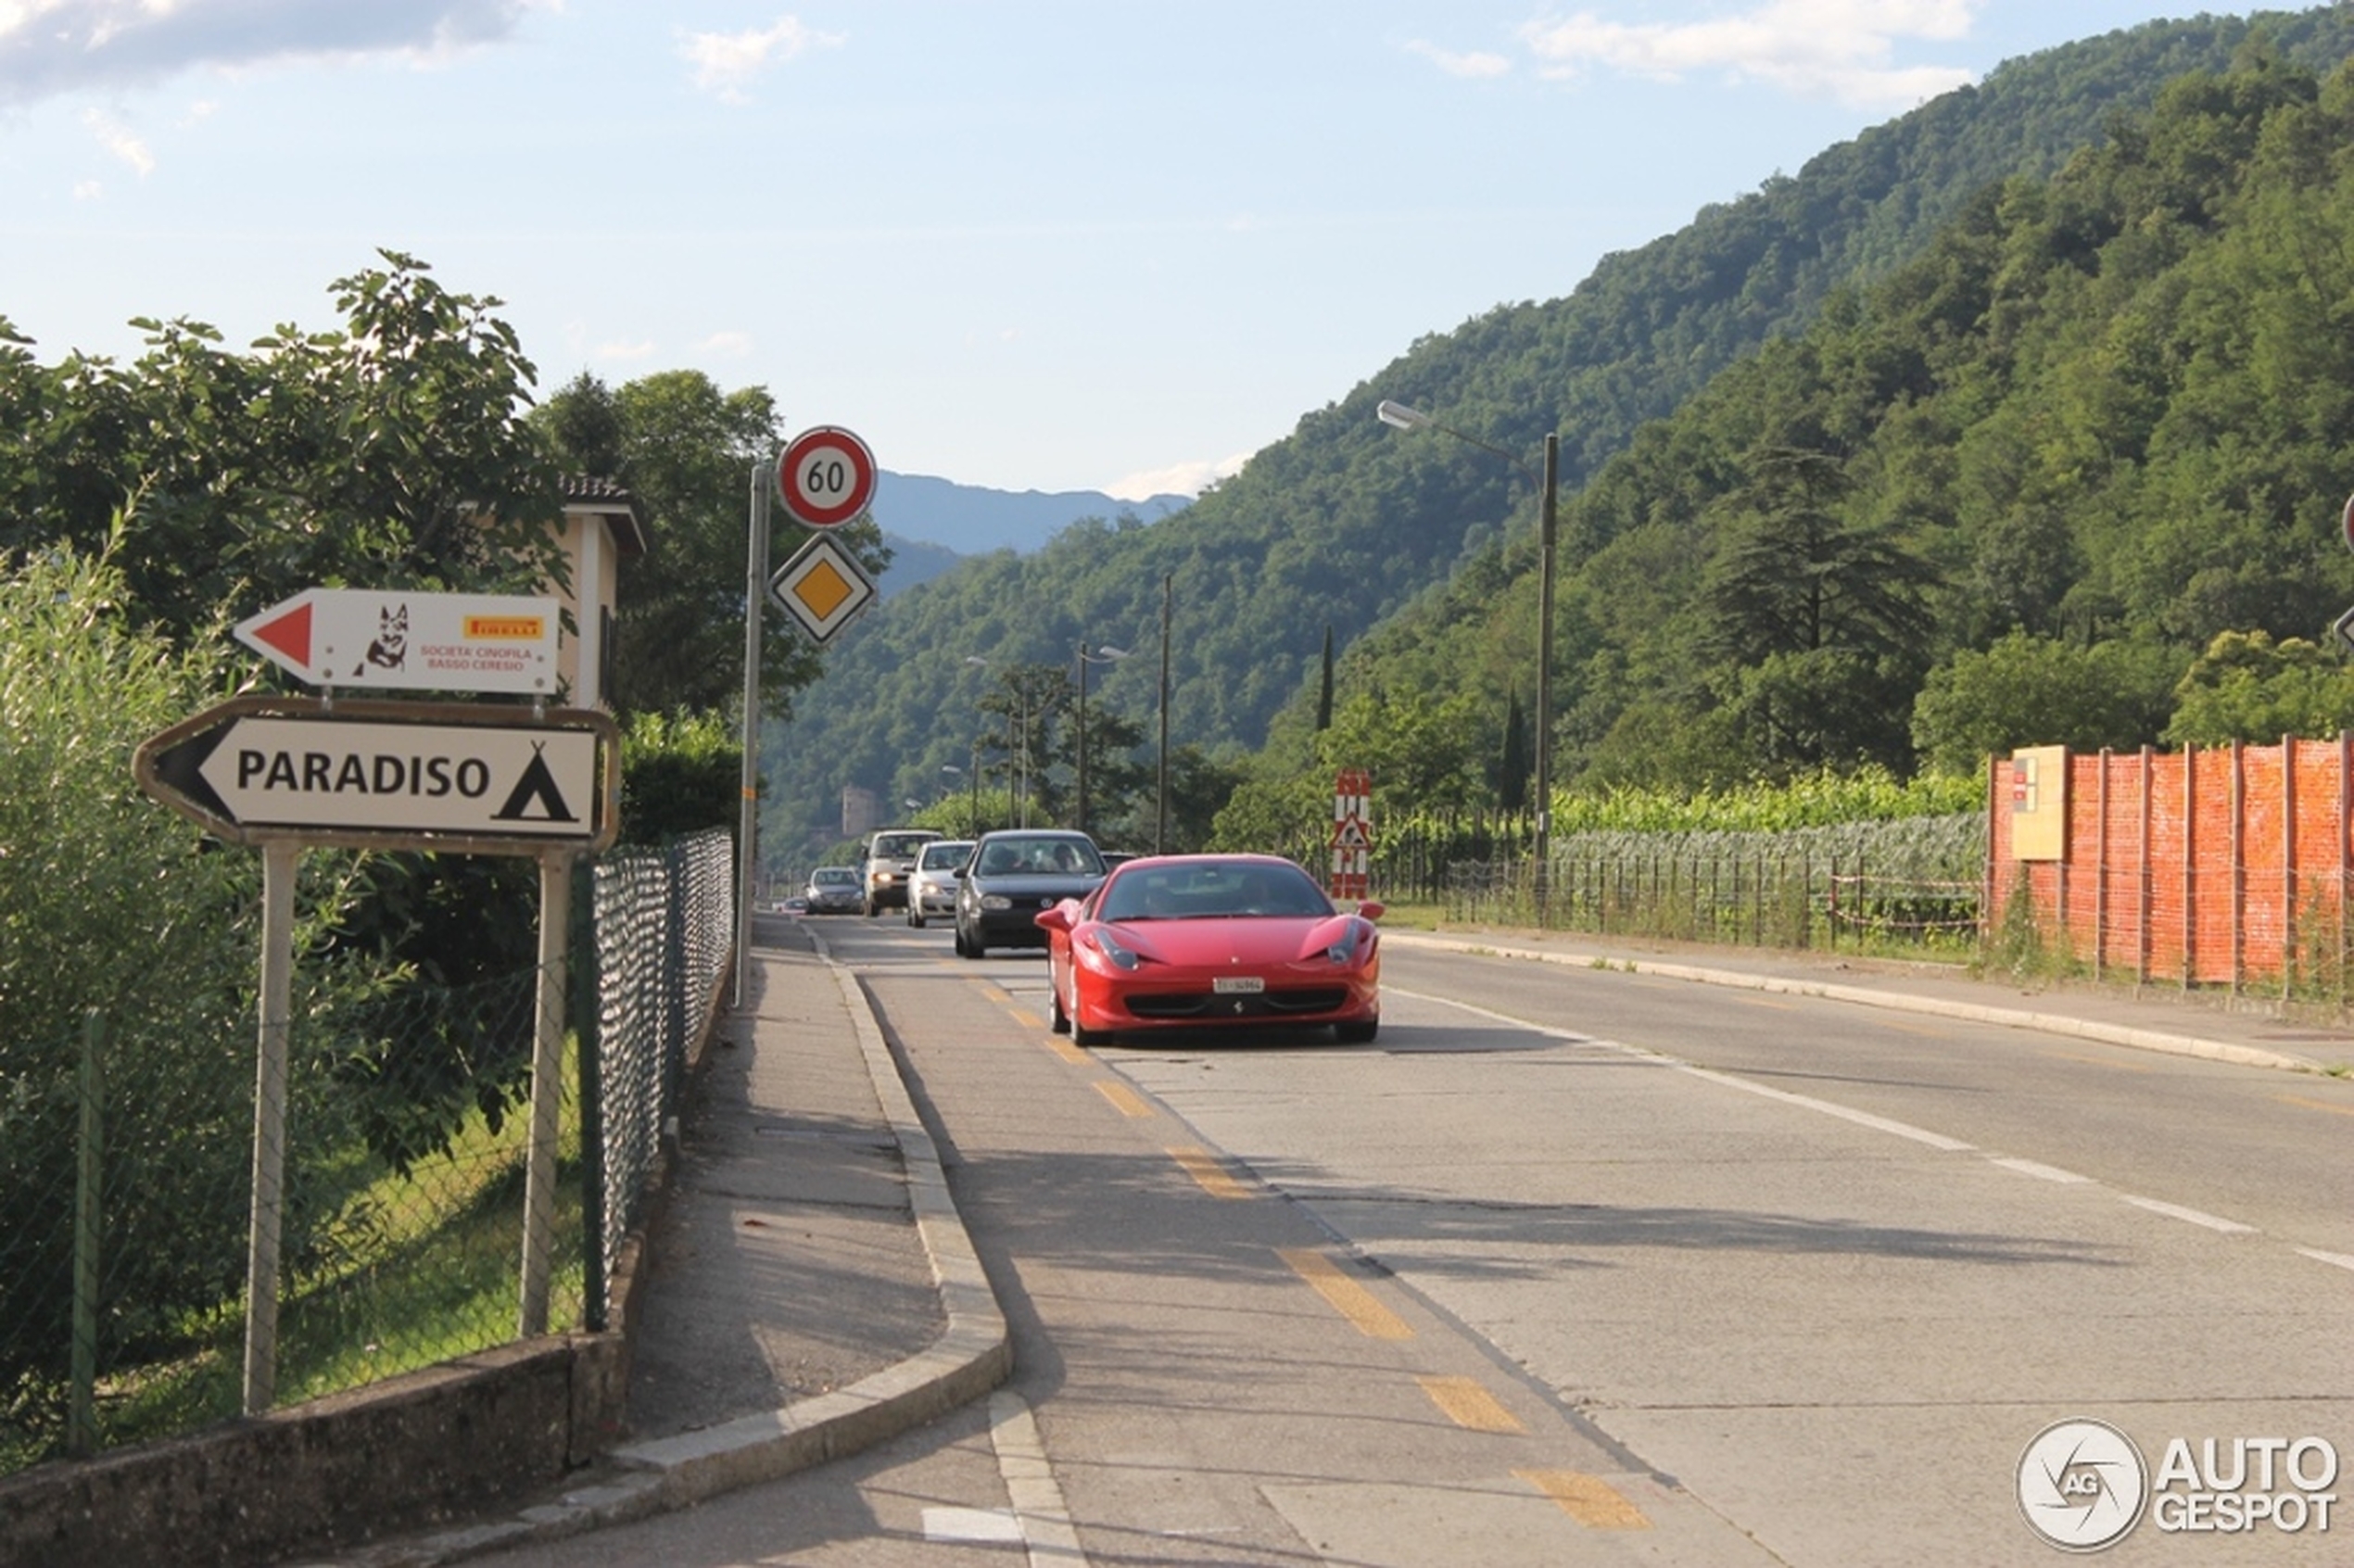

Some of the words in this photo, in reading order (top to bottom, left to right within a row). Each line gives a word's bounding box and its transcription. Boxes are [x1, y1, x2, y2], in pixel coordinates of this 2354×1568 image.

[807, 460, 844, 493] 60
[471, 619, 538, 636] PIRELLI
[475, 648, 532, 659] CINOFILA
[427, 659, 470, 670] BASSO
[473, 660, 524, 672] CERESIO
[237, 749, 490, 799] PARADISO
